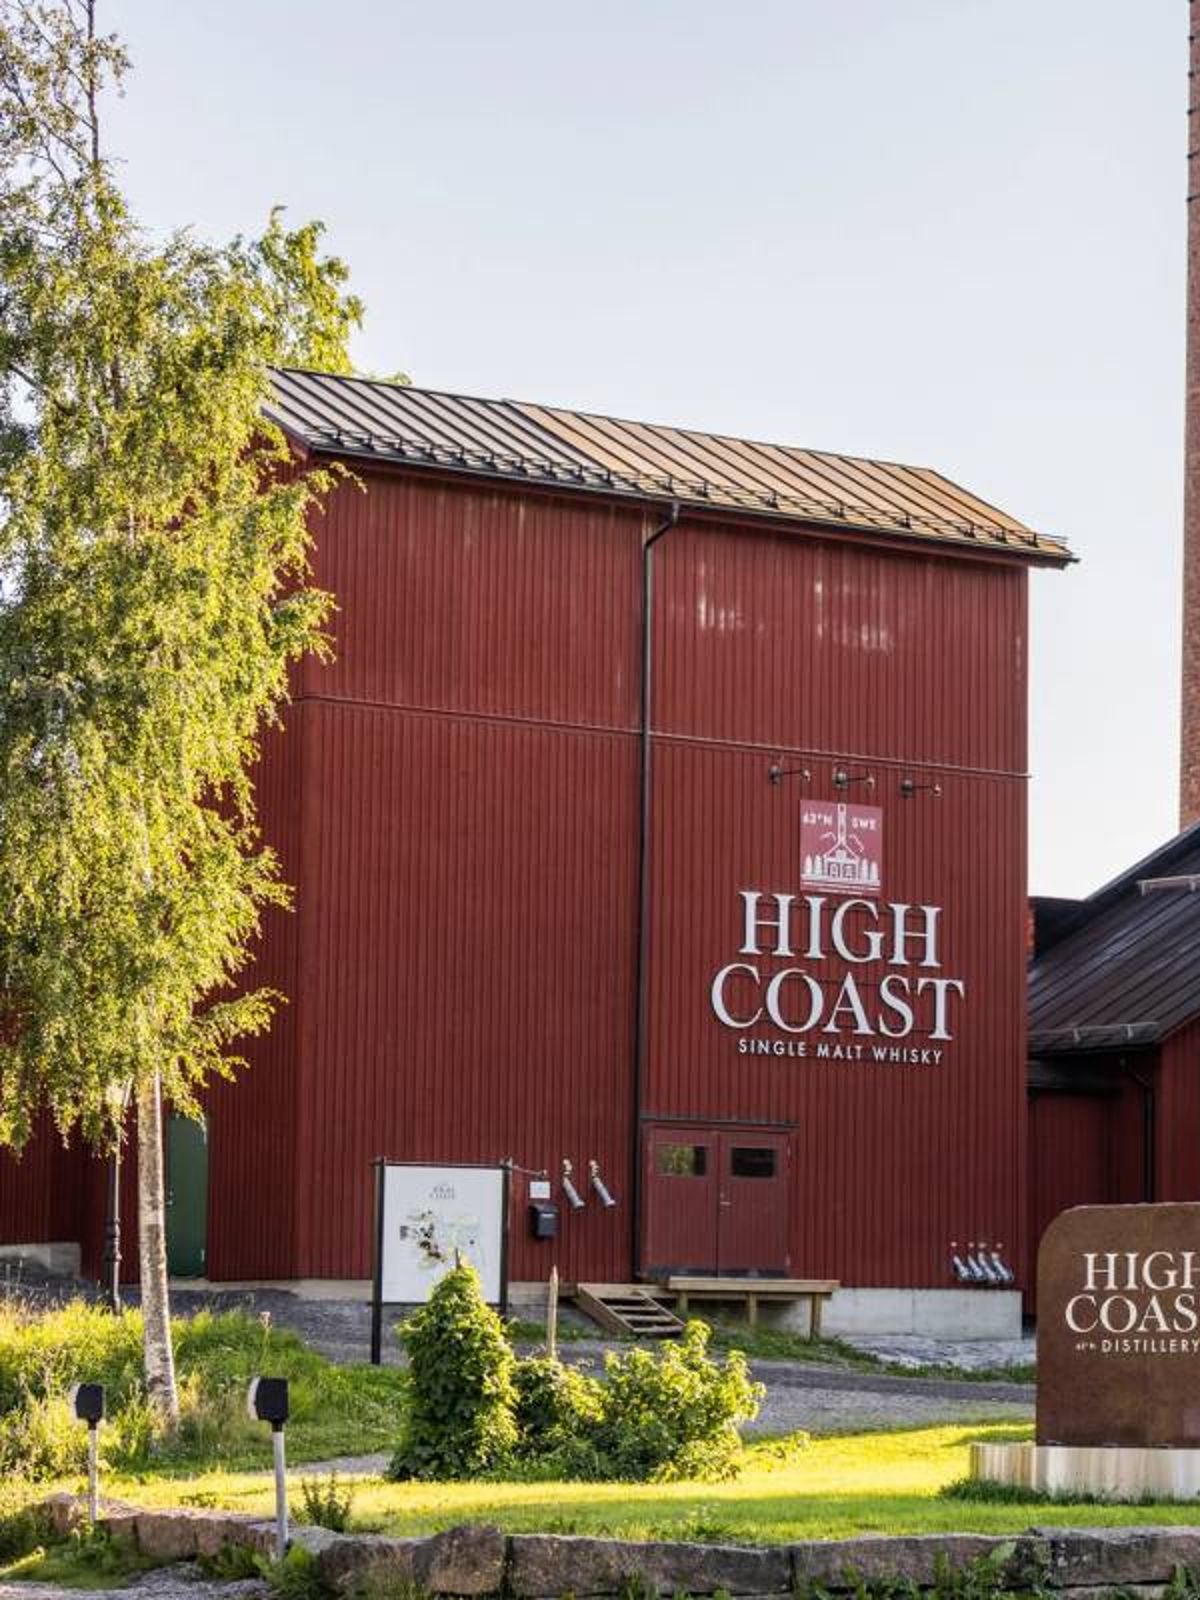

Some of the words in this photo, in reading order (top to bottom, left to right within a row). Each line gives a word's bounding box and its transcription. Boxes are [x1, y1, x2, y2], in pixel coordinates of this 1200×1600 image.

[738, 891, 942, 968] HIGH
[711, 963, 965, 1041] COAST
[738, 1038, 807, 1057] SINGLE
[816, 1043, 863, 1060] MALT
[872, 1046, 943, 1065] WHISKY
[1101, 1339, 1200, 1353] DISTILLERY
